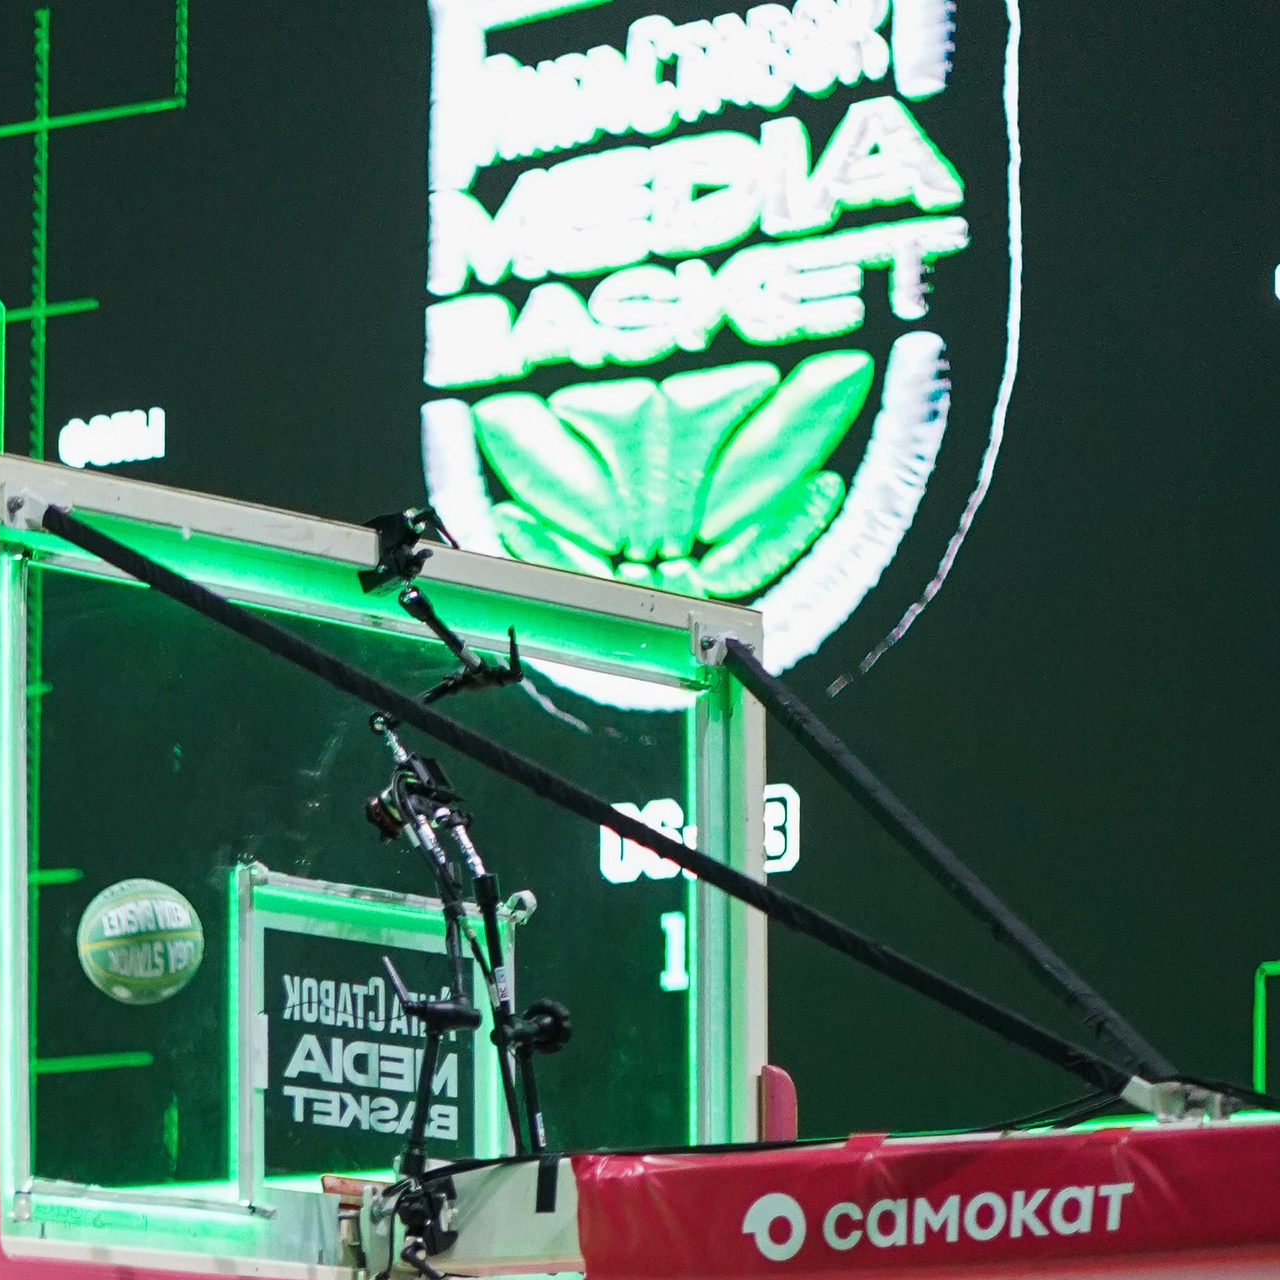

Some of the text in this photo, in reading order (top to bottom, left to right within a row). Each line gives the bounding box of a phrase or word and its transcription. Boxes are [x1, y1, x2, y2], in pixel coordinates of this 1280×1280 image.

[427, 95, 965, 296] MEDIA
[423, 216, 970, 390] BASKET
[660, 911, 689, 992] 1
[823, 1181, 1135, 1252] самокат
